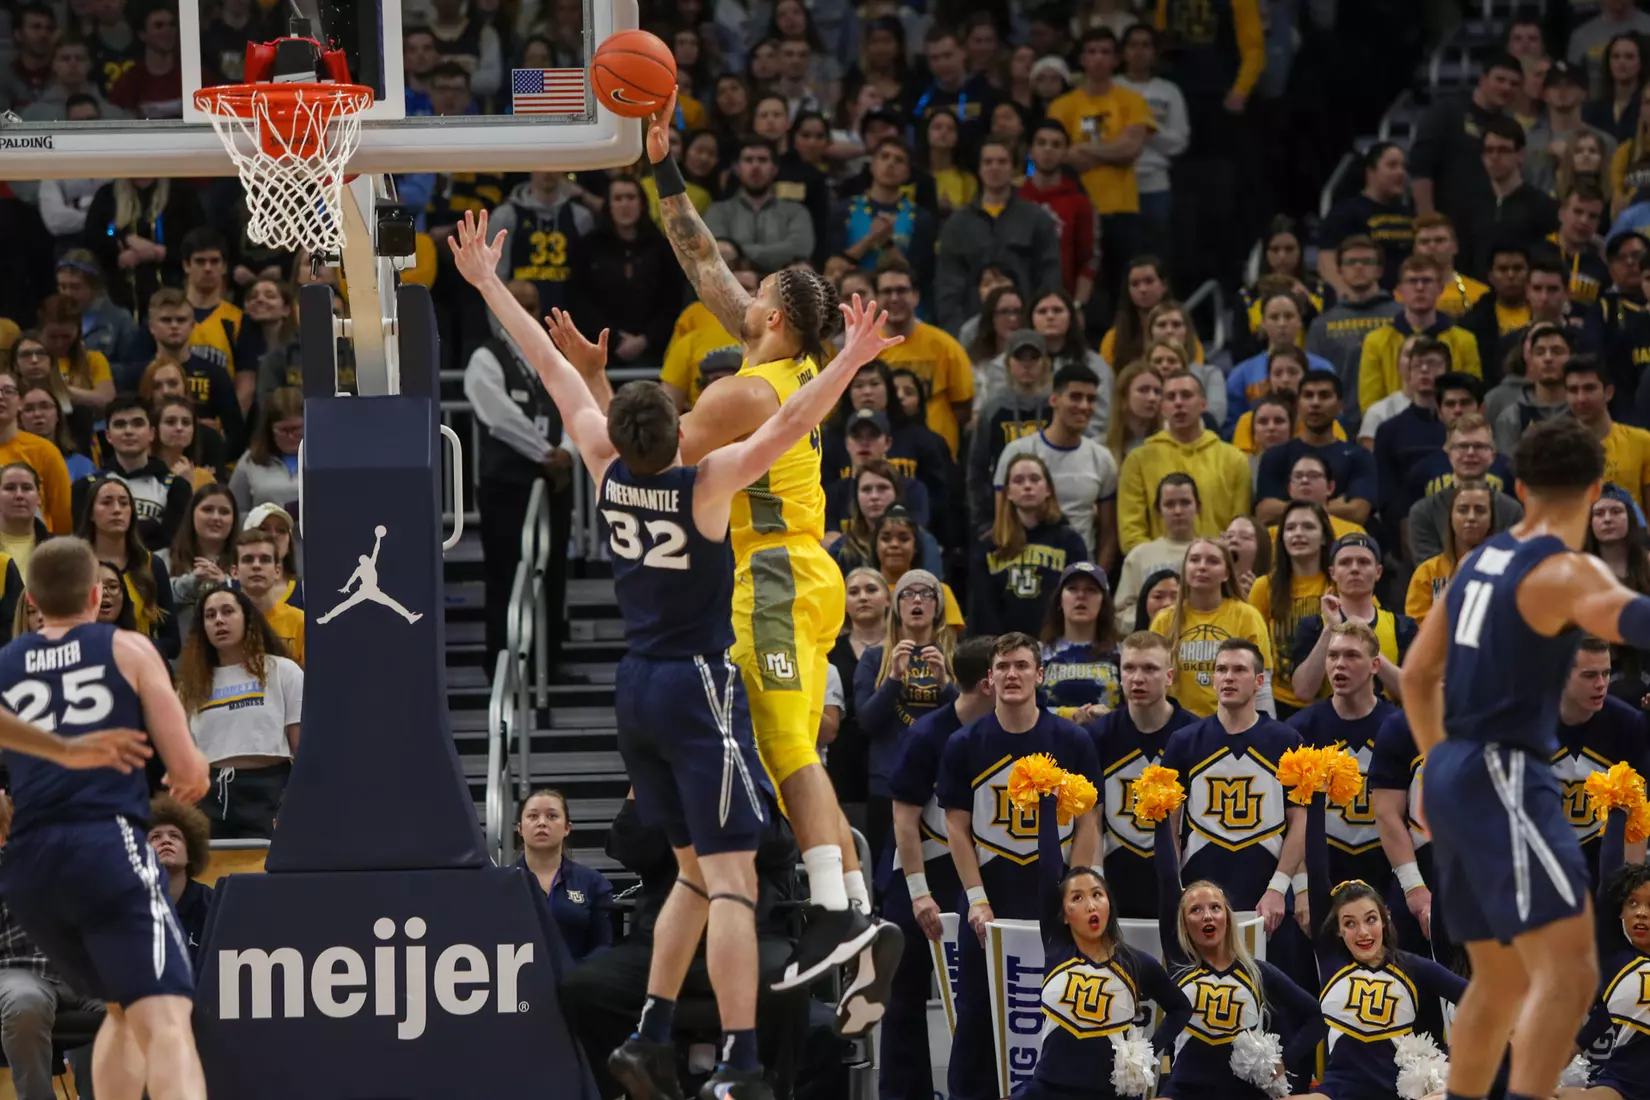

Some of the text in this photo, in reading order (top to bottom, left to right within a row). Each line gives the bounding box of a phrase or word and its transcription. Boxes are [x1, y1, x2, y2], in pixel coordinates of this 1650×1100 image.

[530, 231, 566, 265] 33
[605, 478, 679, 513] FREEMANTLE
[600, 508, 691, 570] 32
[1455, 579, 1494, 649] 11
[25, 640, 81, 673] CARTER
[761, 649, 798, 682] MU
[1, 664, 115, 733] 25
[228, 698, 265, 711] MADNESS
[1202, 775, 1266, 832] MU
[566, 889, 585, 904] MU
[218, 916, 534, 1040] meijer
[1007, 955, 1045, 1034] OUT
[1058, 969, 1116, 1026] MU
[1343, 976, 1402, 1029] MU
[1192, 979, 1246, 1034] MU
